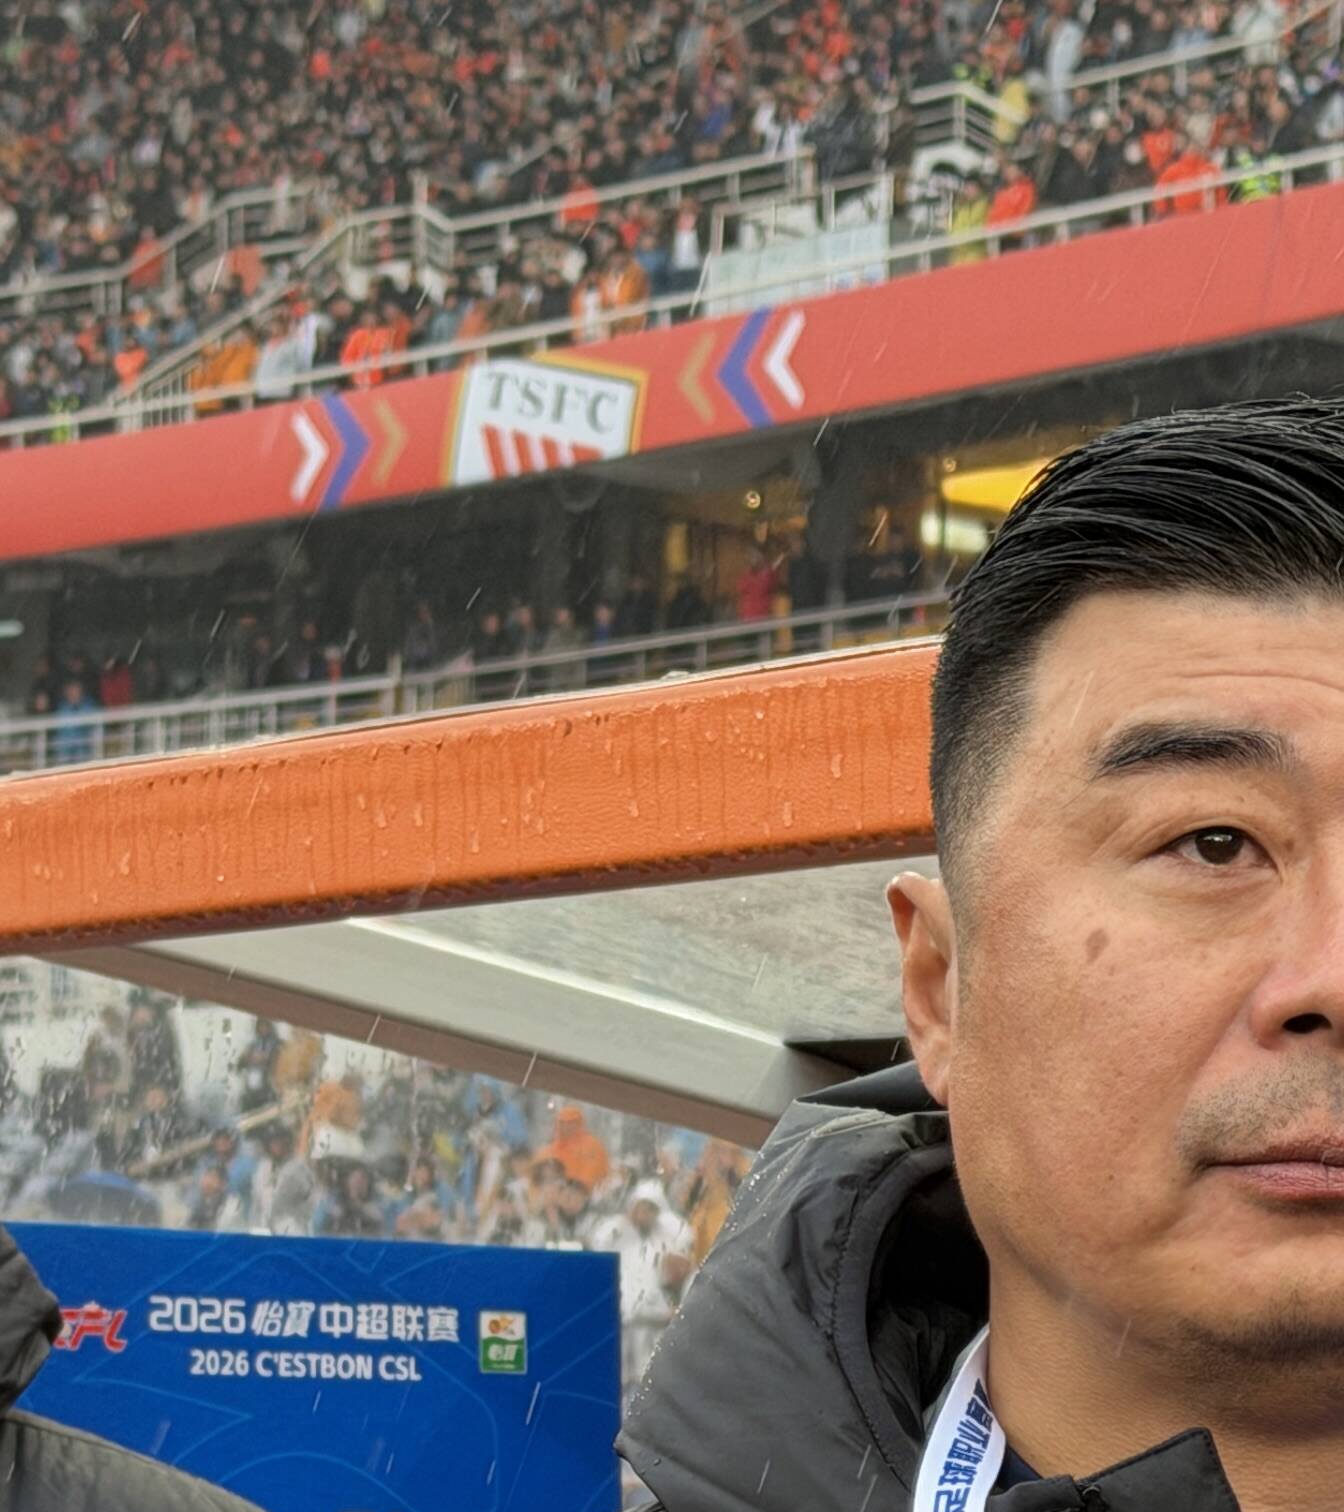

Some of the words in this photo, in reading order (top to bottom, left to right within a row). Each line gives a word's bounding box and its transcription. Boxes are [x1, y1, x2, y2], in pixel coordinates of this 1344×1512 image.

[485, 370, 619, 434] TSFC
[149, 1295, 246, 1334] 2026
[190, 1349, 249, 1378] 2026
[255, 1352, 372, 1381] C'ESTBON
[379, 1355, 422, 1382] CSL
